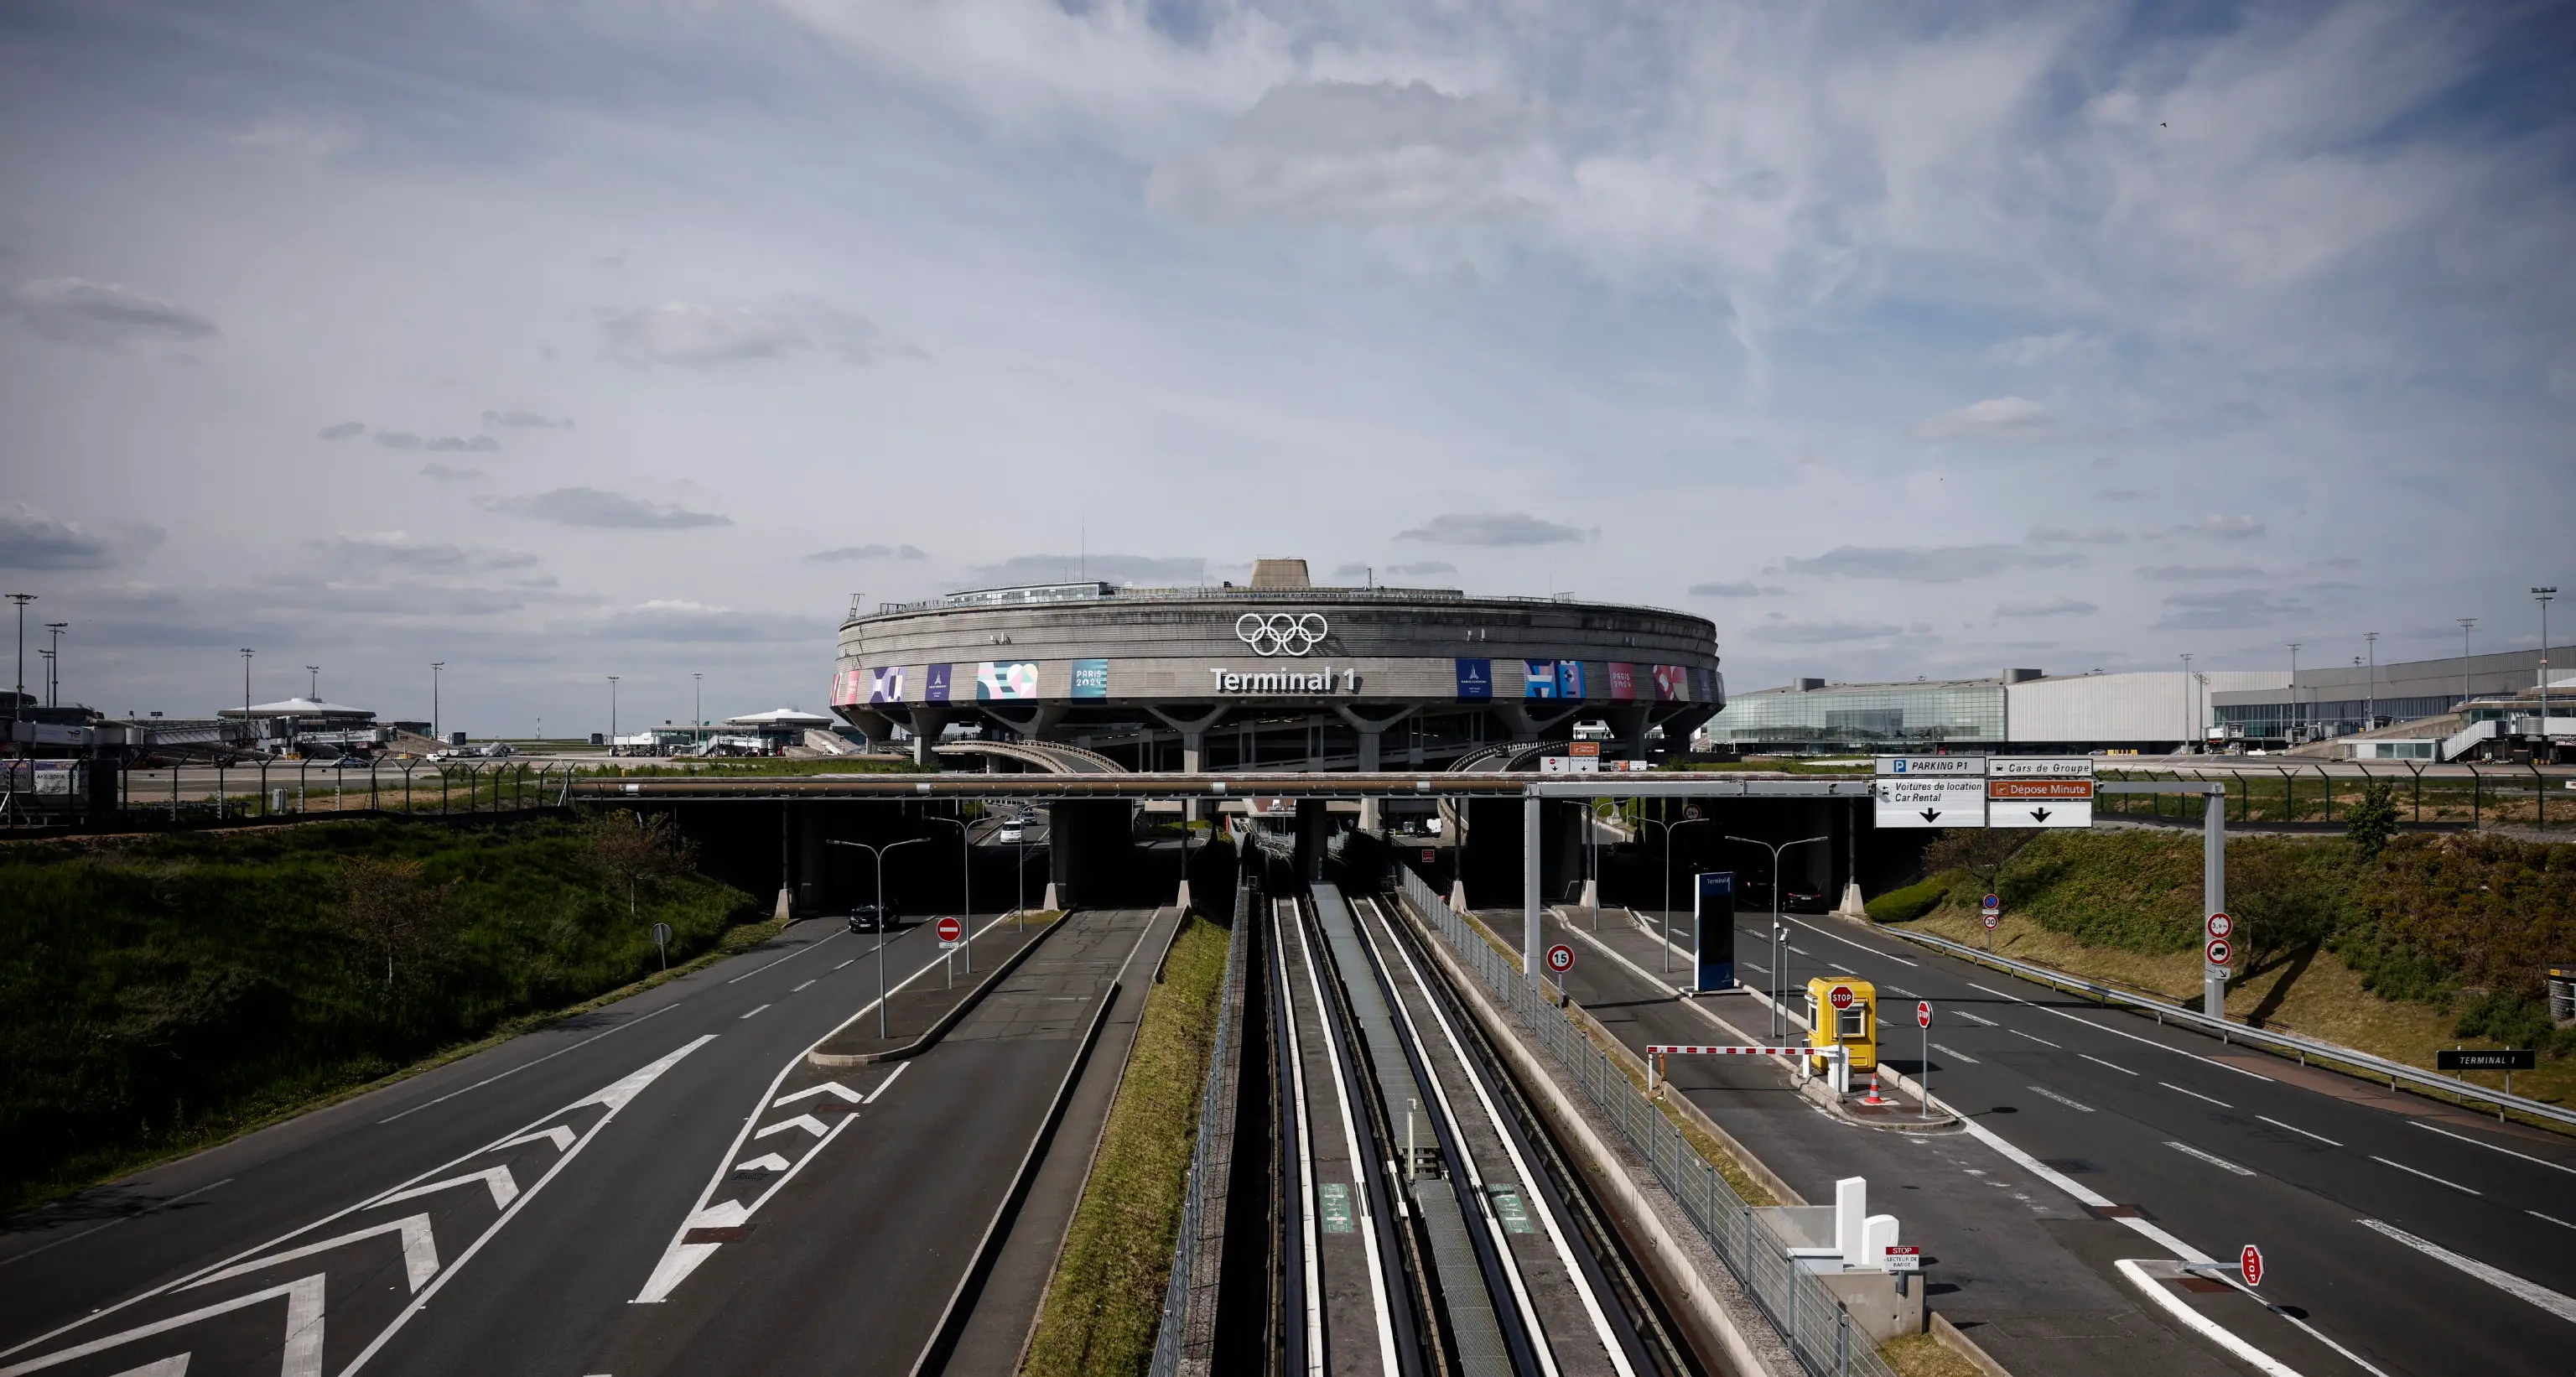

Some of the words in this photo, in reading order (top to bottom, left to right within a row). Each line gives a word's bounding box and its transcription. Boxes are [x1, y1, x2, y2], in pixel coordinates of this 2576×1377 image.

[1210, 667, 1331, 690] Terminal
[1343, 668, 1354, 690] 1
[1912, 761, 1954, 771] PARKING
[1956, 761, 1968, 770] P1
[2008, 763, 2032, 772] Cars
[2036, 764, 2049, 772] de
[2053, 763, 2090, 774] Groupe
[1895, 782, 1931, 791] Voitures
[1934, 782, 1945, 791] de
[1946, 782, 1982, 791] location
[2011, 784, 2048, 796] Dépose
[2050, 784, 2086, 794] Minute
[1895, 793, 1910, 802] Car
[1913, 793, 1941, 802] Rental
[1554, 954, 1566, 964] 15
[2247, 1250, 2256, 1281] STOP
